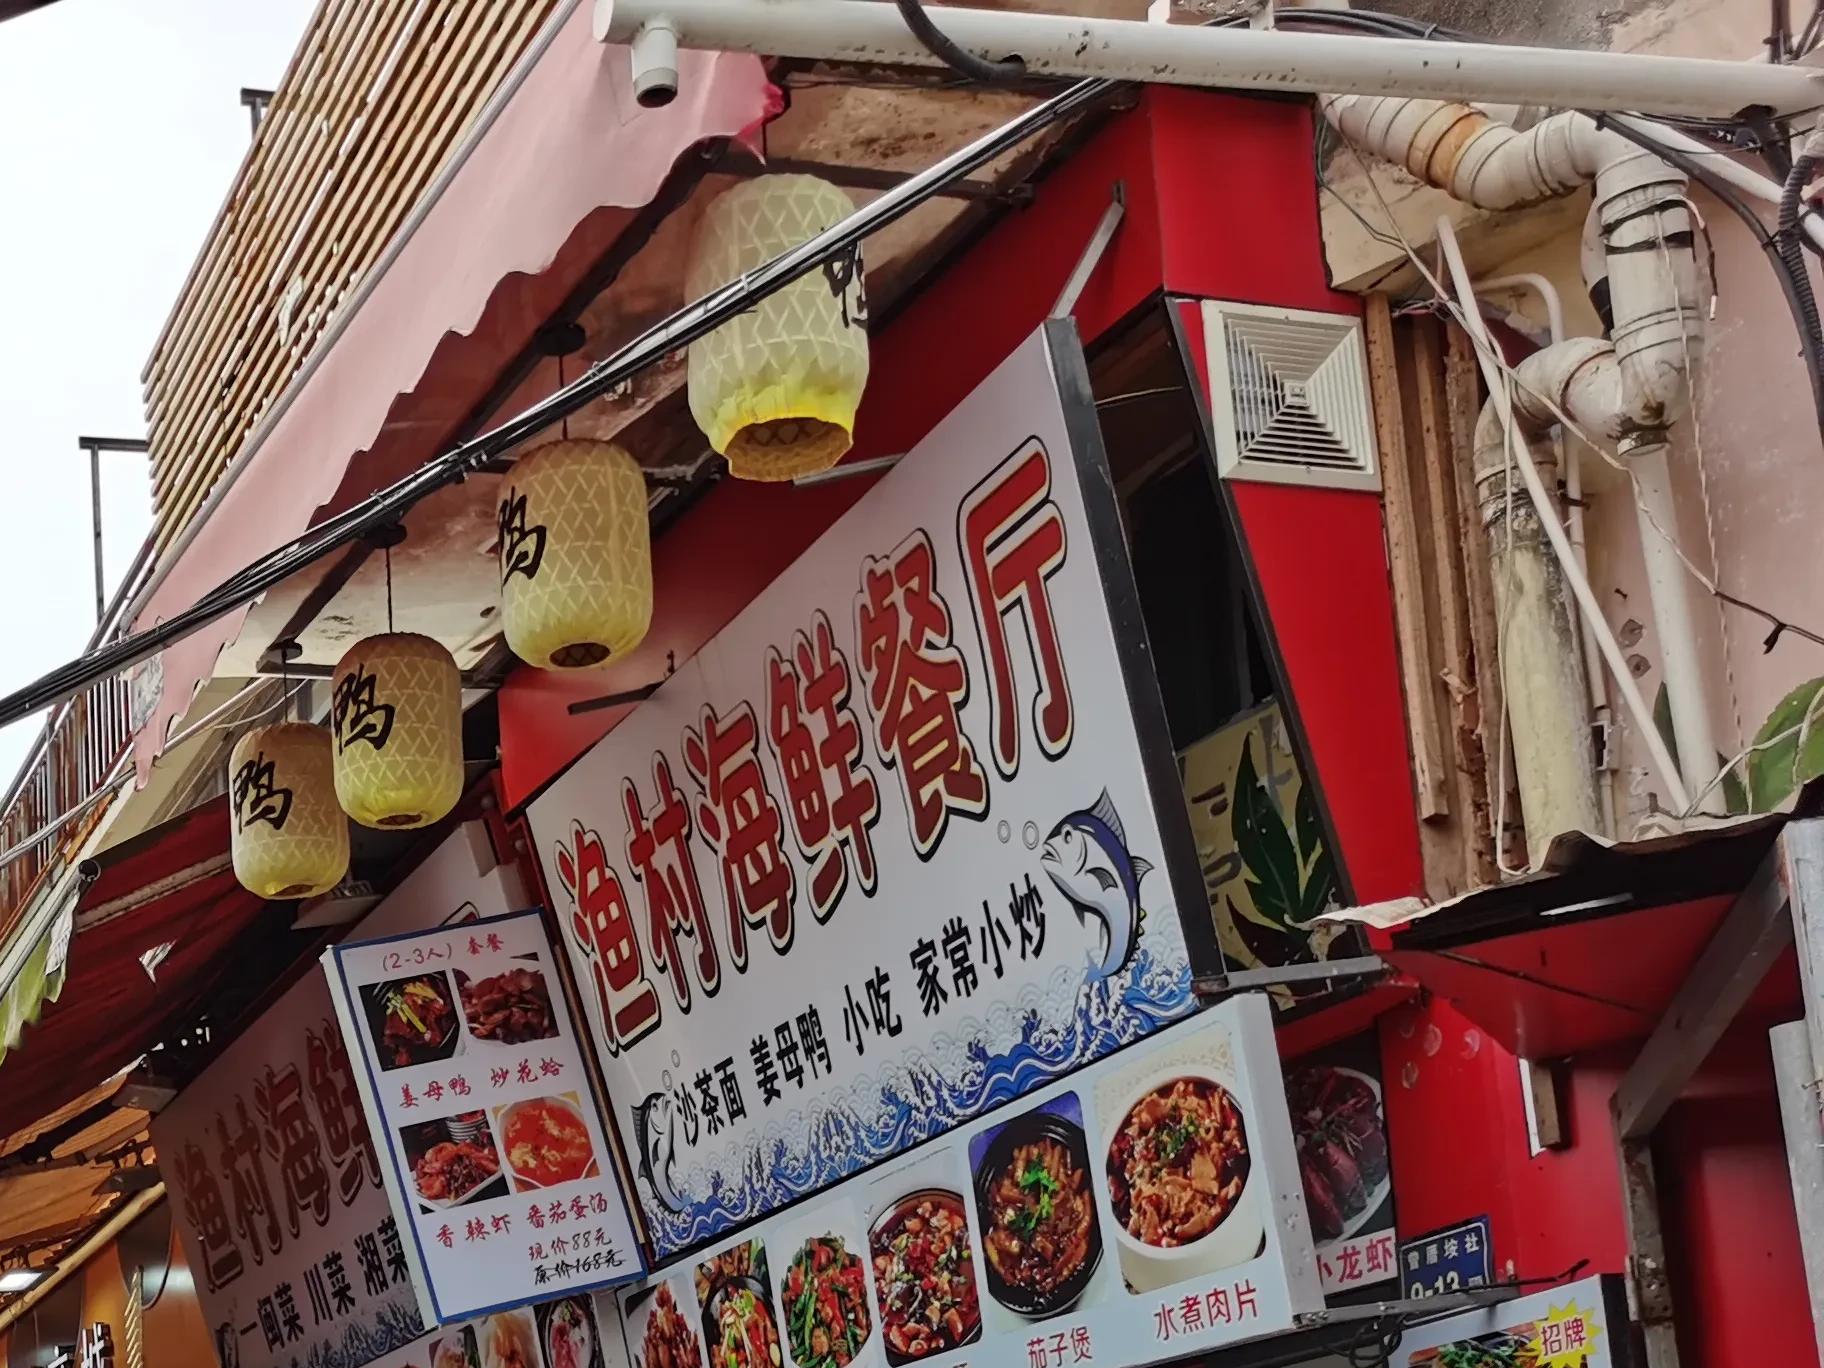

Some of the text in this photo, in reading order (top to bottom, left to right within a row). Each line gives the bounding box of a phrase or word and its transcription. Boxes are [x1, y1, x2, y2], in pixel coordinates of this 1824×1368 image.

[333, 664, 395, 756] 鸭
[556, 436, 1076, 1057] 渔村海鲜餐厅
[233, 751, 293, 831] 鸭
[468, 934, 504, 954] 套餐
[673, 873, 1047, 1148] 沙茶面 姜母鸭 小吃 家常小炒
[399, 1058, 564, 1109] 姜母鸭 炒花蛤
[436, 1193, 608, 1248] 香辣虾 番茄蛋汤
[303, 1248, 356, 1326] 川菜
[356, 1213, 412, 1307] 湘菜
[1153, 1282, 1259, 1342] 水煮肉片
[1541, 1322, 1586, 1357] 招牌
